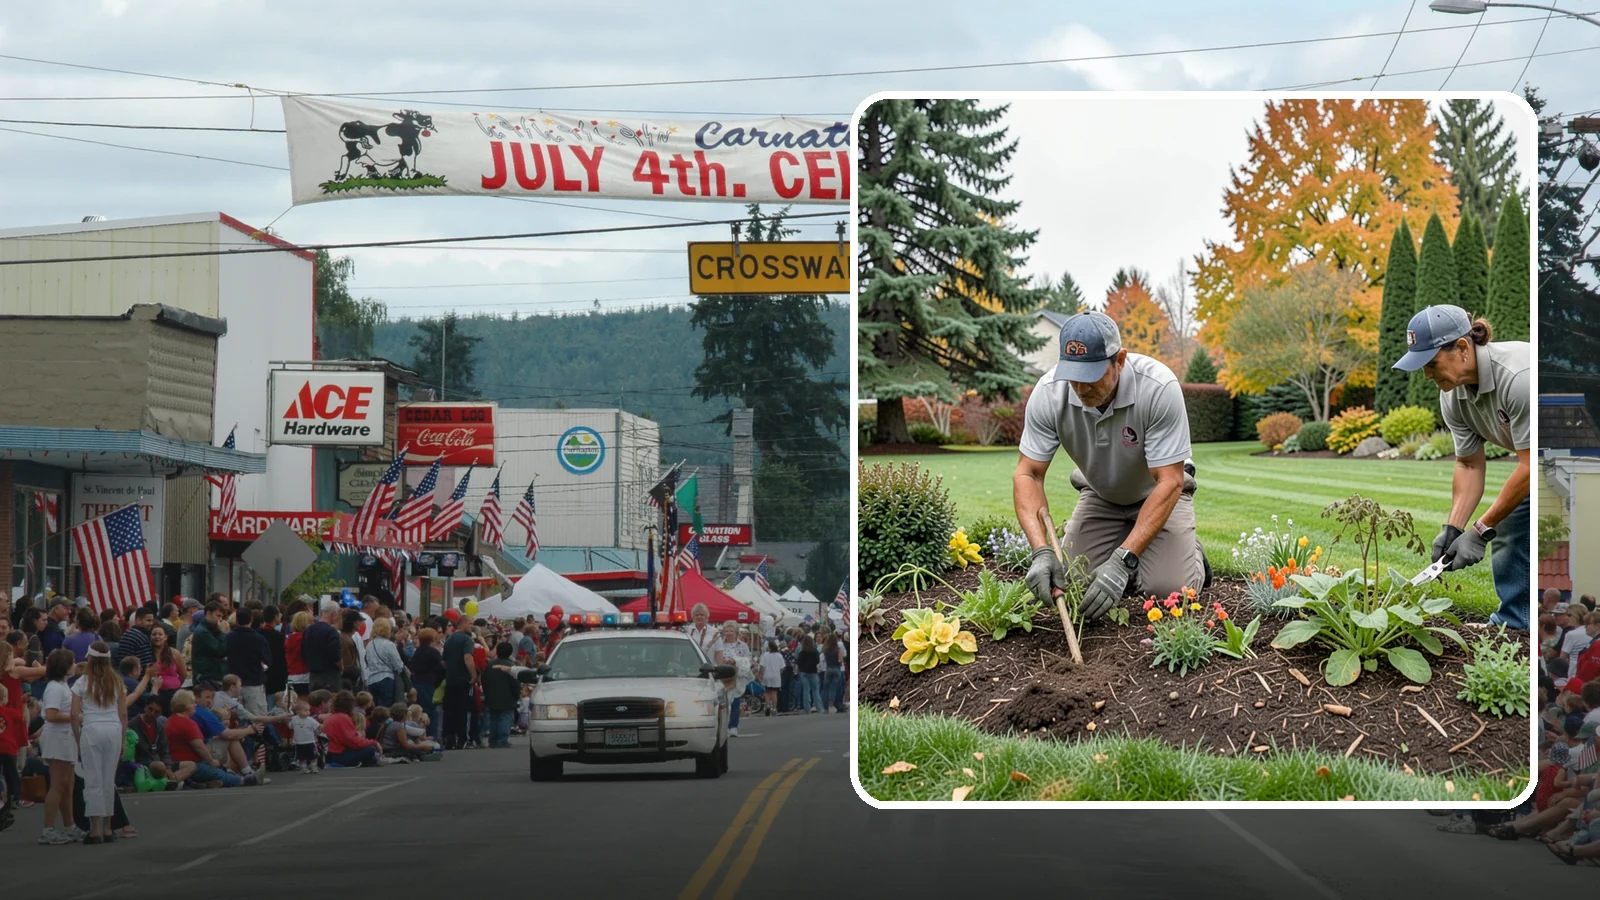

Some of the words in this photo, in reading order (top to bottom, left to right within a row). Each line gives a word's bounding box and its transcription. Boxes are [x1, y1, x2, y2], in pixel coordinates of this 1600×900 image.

[481, 141, 605, 192] JULY
[632, 150, 746, 198] 4th.
[697, 254, 850, 280] CROSSWA
[282, 380, 374, 420] ACE
[405, 409, 453, 421] CEDAR
[461, 409, 485, 421] LOG
[283, 421, 371, 436] Hardware
[416, 428, 476, 447] Coca-Cola
[353, 467, 386, 479] Simpl
[83, 486, 93, 494] St.
[95, 485, 124, 495] Vincent
[126, 486, 136, 495] de
[138, 486, 155, 495] Paul
[81, 503, 153, 522] THT
[688, 527, 741, 535] CRNATION
[699, 535, 730, 543] GLASS
